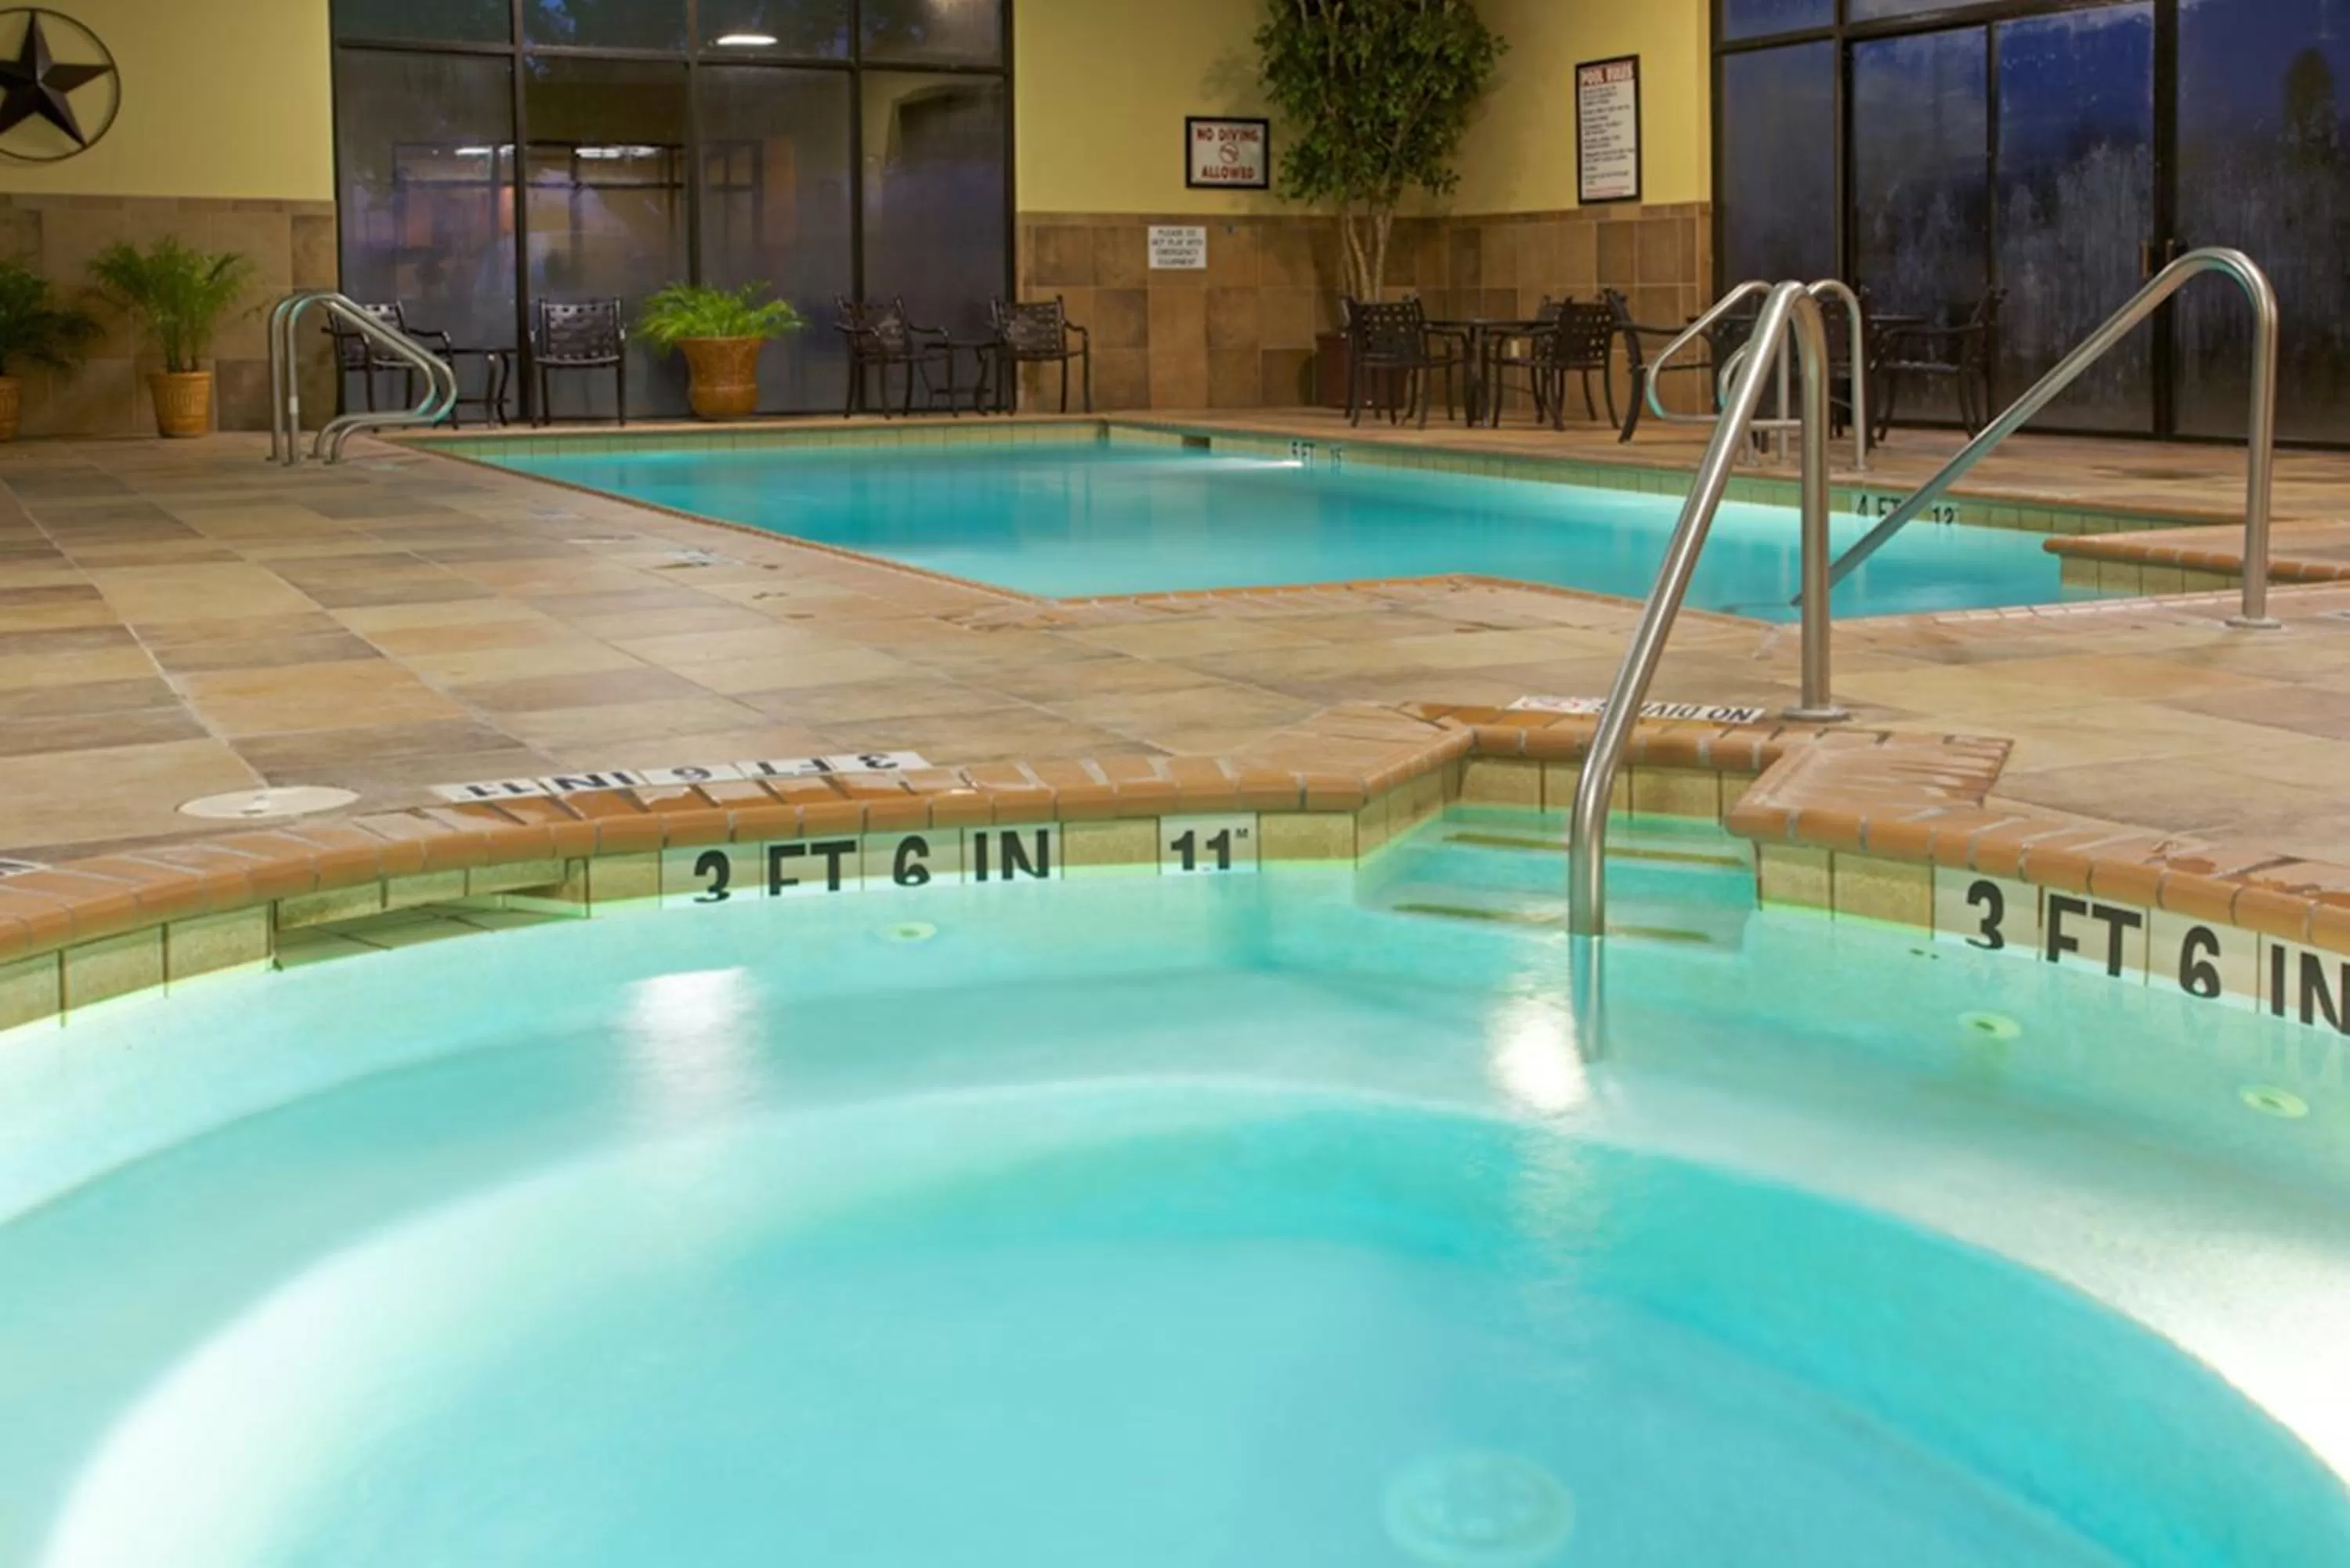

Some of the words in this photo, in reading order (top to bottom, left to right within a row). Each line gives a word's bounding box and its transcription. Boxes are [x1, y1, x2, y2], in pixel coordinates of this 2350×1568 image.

[1196, 128, 1214, 141] NO
[1218, 128, 1260, 142] DIVING
[1202, 166, 1255, 179] ALLOWED
[1856, 494, 1868, 517] 4
[1707, 707, 1755, 721] NO
[859, 753, 898, 769] 3
[553, 771, 637, 790] IN
[671, 767, 712, 780] 6
[694, 850, 731, 904] 3
[768, 840, 856, 897] FT
[893, 835, 931, 886] 6
[974, 829, 1048, 882] IN
[1965, 879, 2005, 950] 3
[2046, 893, 2142, 978] FT
[2179, 925, 2222, 999] 6
[2270, 944, 2350, 1036] IN
